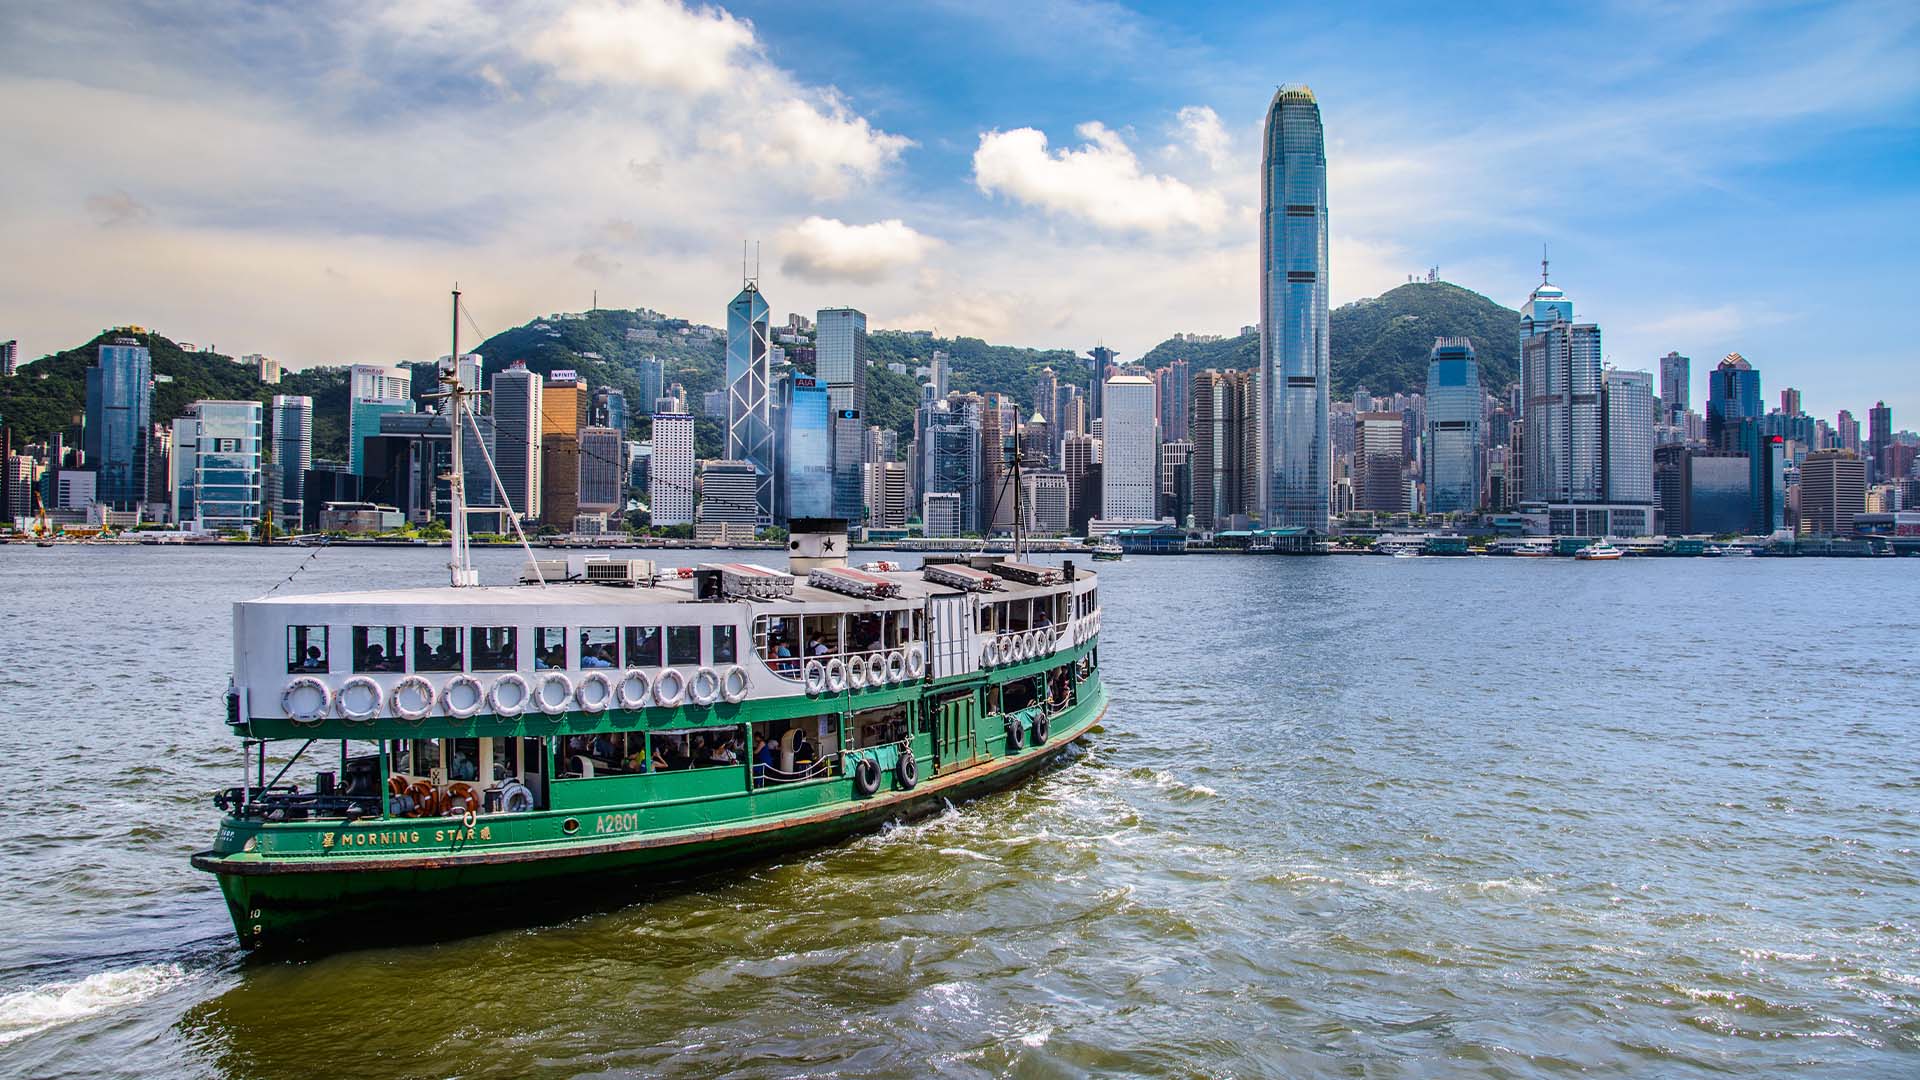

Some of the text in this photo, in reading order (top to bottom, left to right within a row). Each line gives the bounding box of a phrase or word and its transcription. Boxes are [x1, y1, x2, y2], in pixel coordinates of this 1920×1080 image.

[596, 813, 638, 833] A2801
[341, 831, 420, 846] MORNING
[435, 827, 476, 842] STAR
[250, 909, 261, 919] 10
[253, 925, 262, 935] 9
